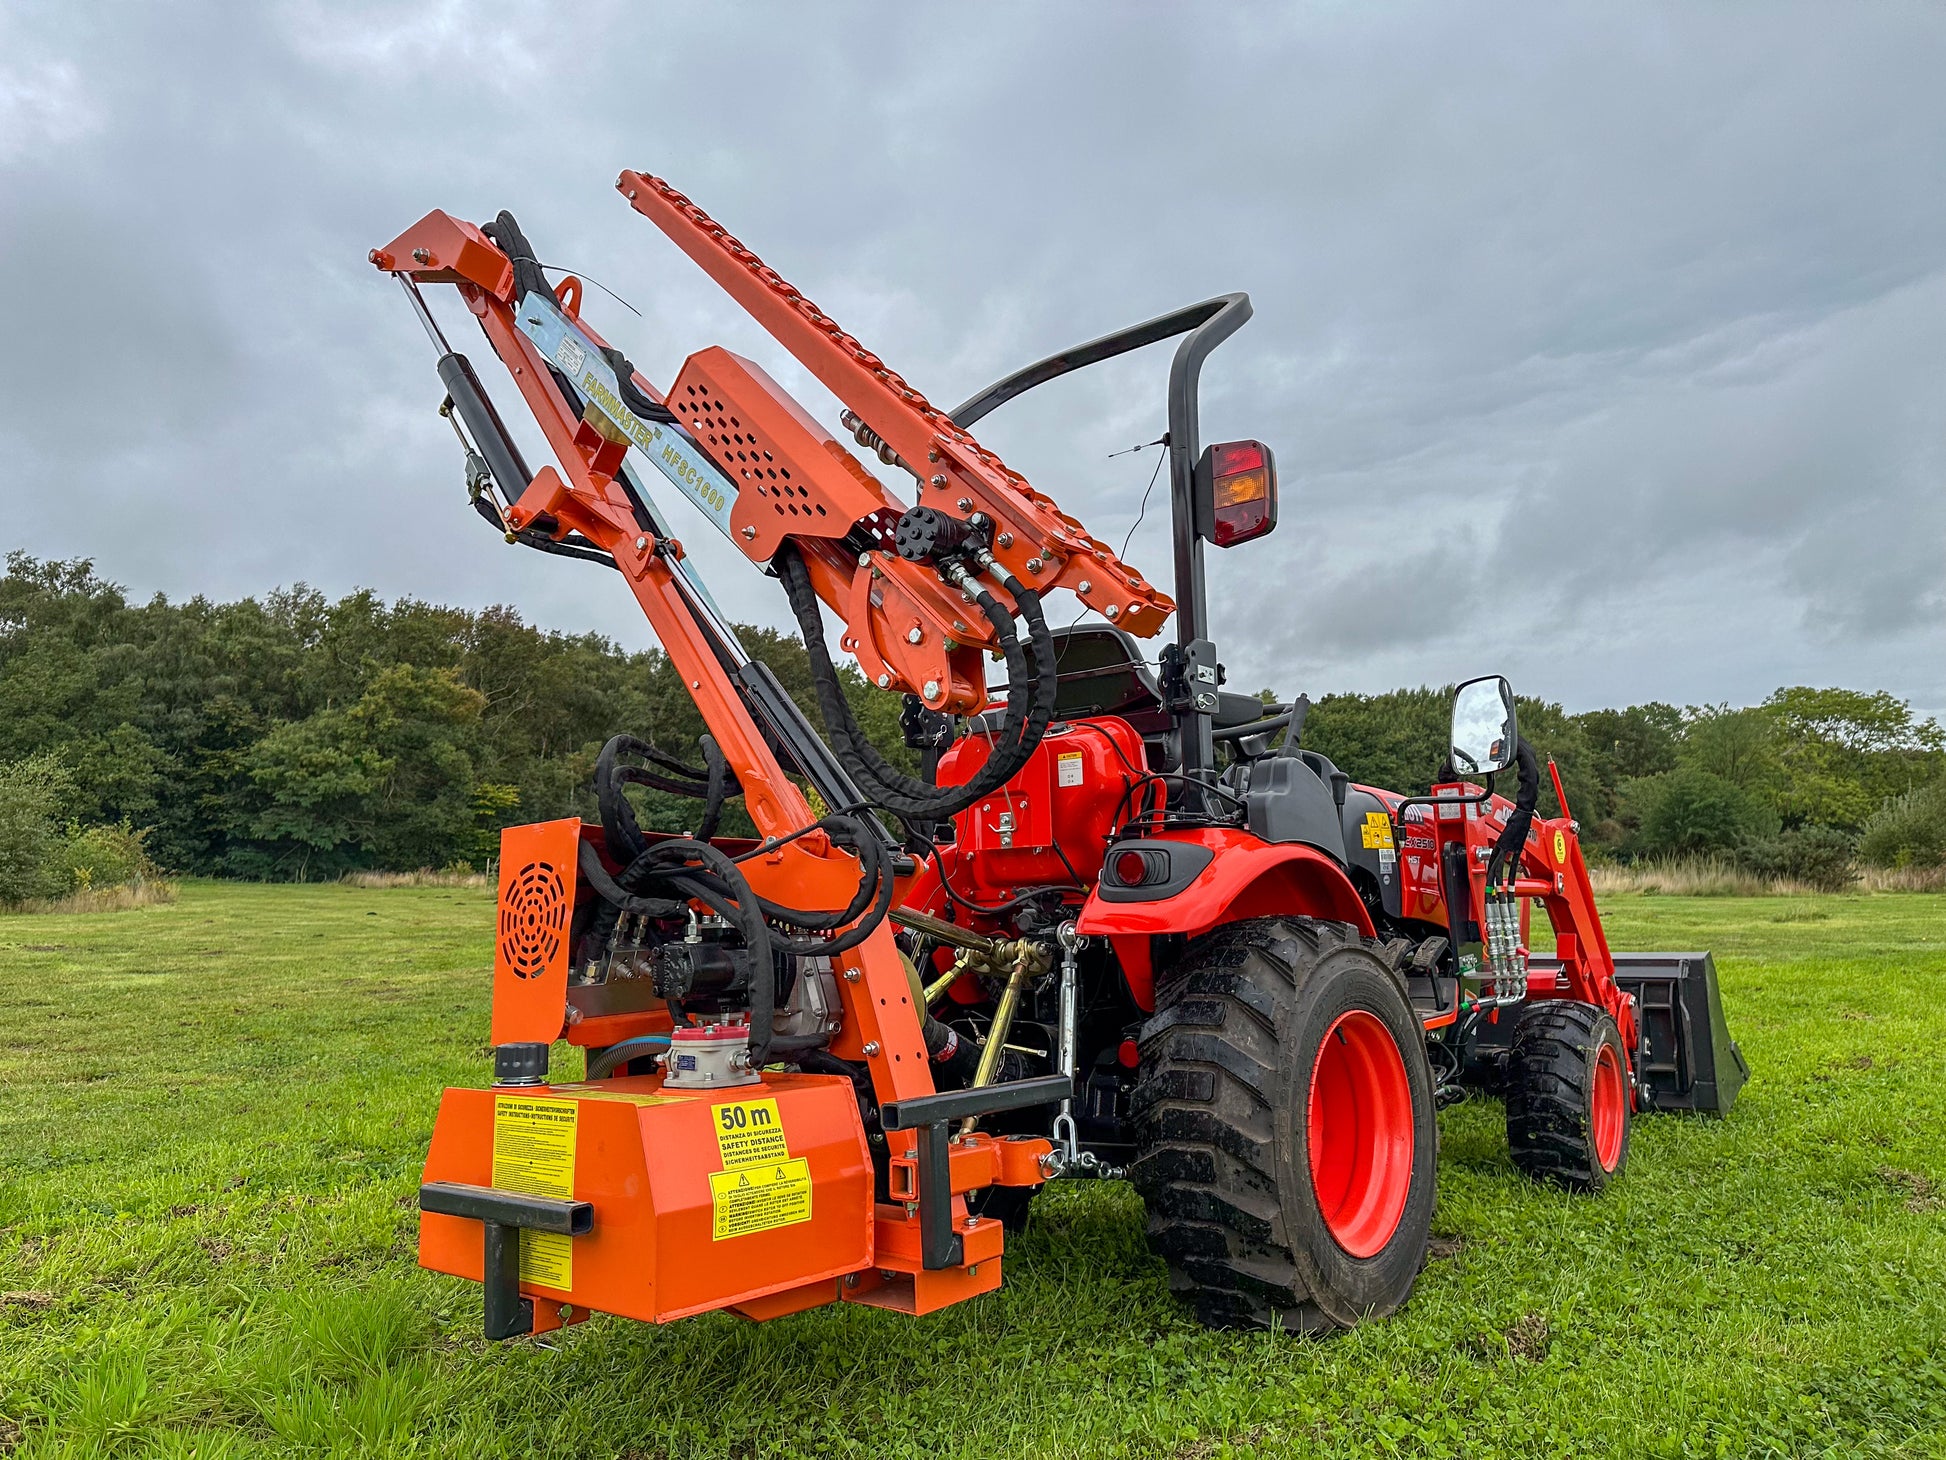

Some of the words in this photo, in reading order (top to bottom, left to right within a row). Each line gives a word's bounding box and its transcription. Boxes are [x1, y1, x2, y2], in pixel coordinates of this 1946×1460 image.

[582, 371, 654, 450] FARMMASTER
[662, 444, 725, 512] HFSC1600
[721, 1106, 746, 1130] 50
[750, 1108, 771, 1126] m
[720, 1132, 746, 1141] DISTANZA
[753, 1128, 781, 1136] SICUREZZA
[722, 1140, 748, 1150] SAFETY
[750, 1135, 784, 1146] DISTANCE
[723, 1149, 752, 1158] DISTANCES
[761, 1143, 785, 1152] SECURITE
